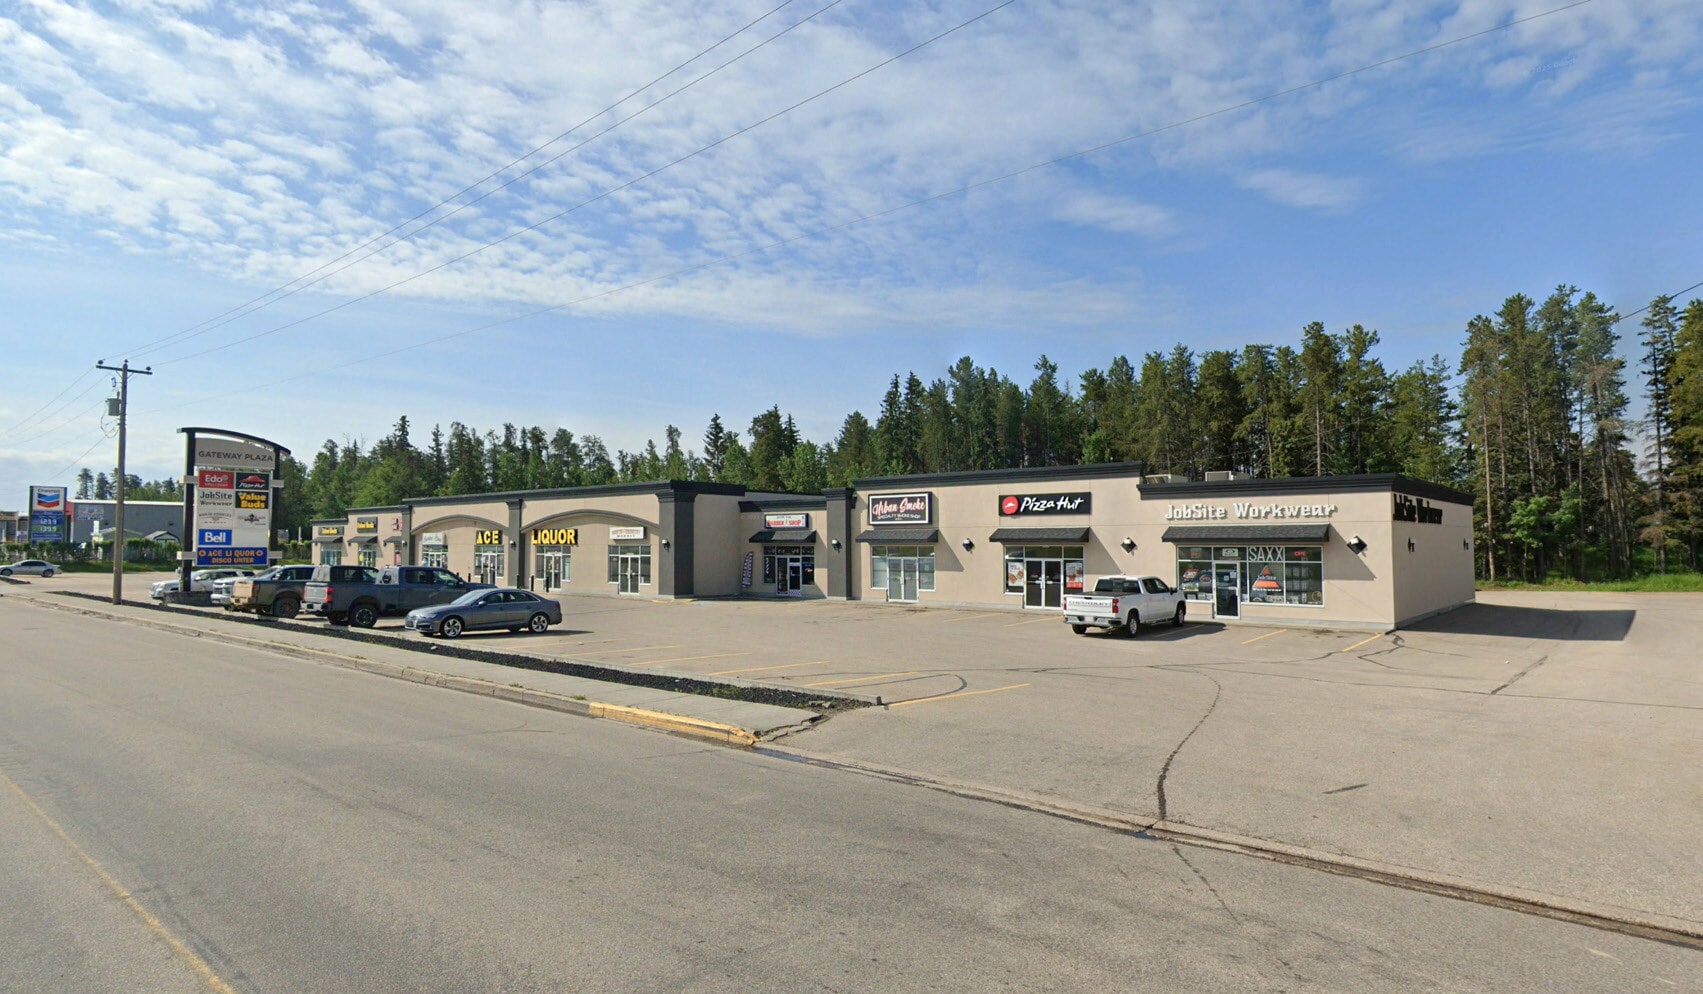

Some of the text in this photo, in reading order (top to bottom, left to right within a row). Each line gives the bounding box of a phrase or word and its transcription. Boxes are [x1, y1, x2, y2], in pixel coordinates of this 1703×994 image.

[198, 450, 273, 462] GATEWAY PLAZA
[205, 474, 223, 483] Edo
[200, 491, 233, 499] JobSite
[240, 493, 267, 501] Value
[241, 500, 265, 508] Buds
[872, 497, 925, 516] Urban Smoke
[1020, 496, 1084, 512] Pizza Hut
[1165, 502, 1340, 520] JobSite Workwear
[205, 532, 226, 543] Bell
[476, 530, 499, 544] ACE
[531, 529, 576, 545] LIQUOR
[1249, 546, 1284, 561] SAXX
